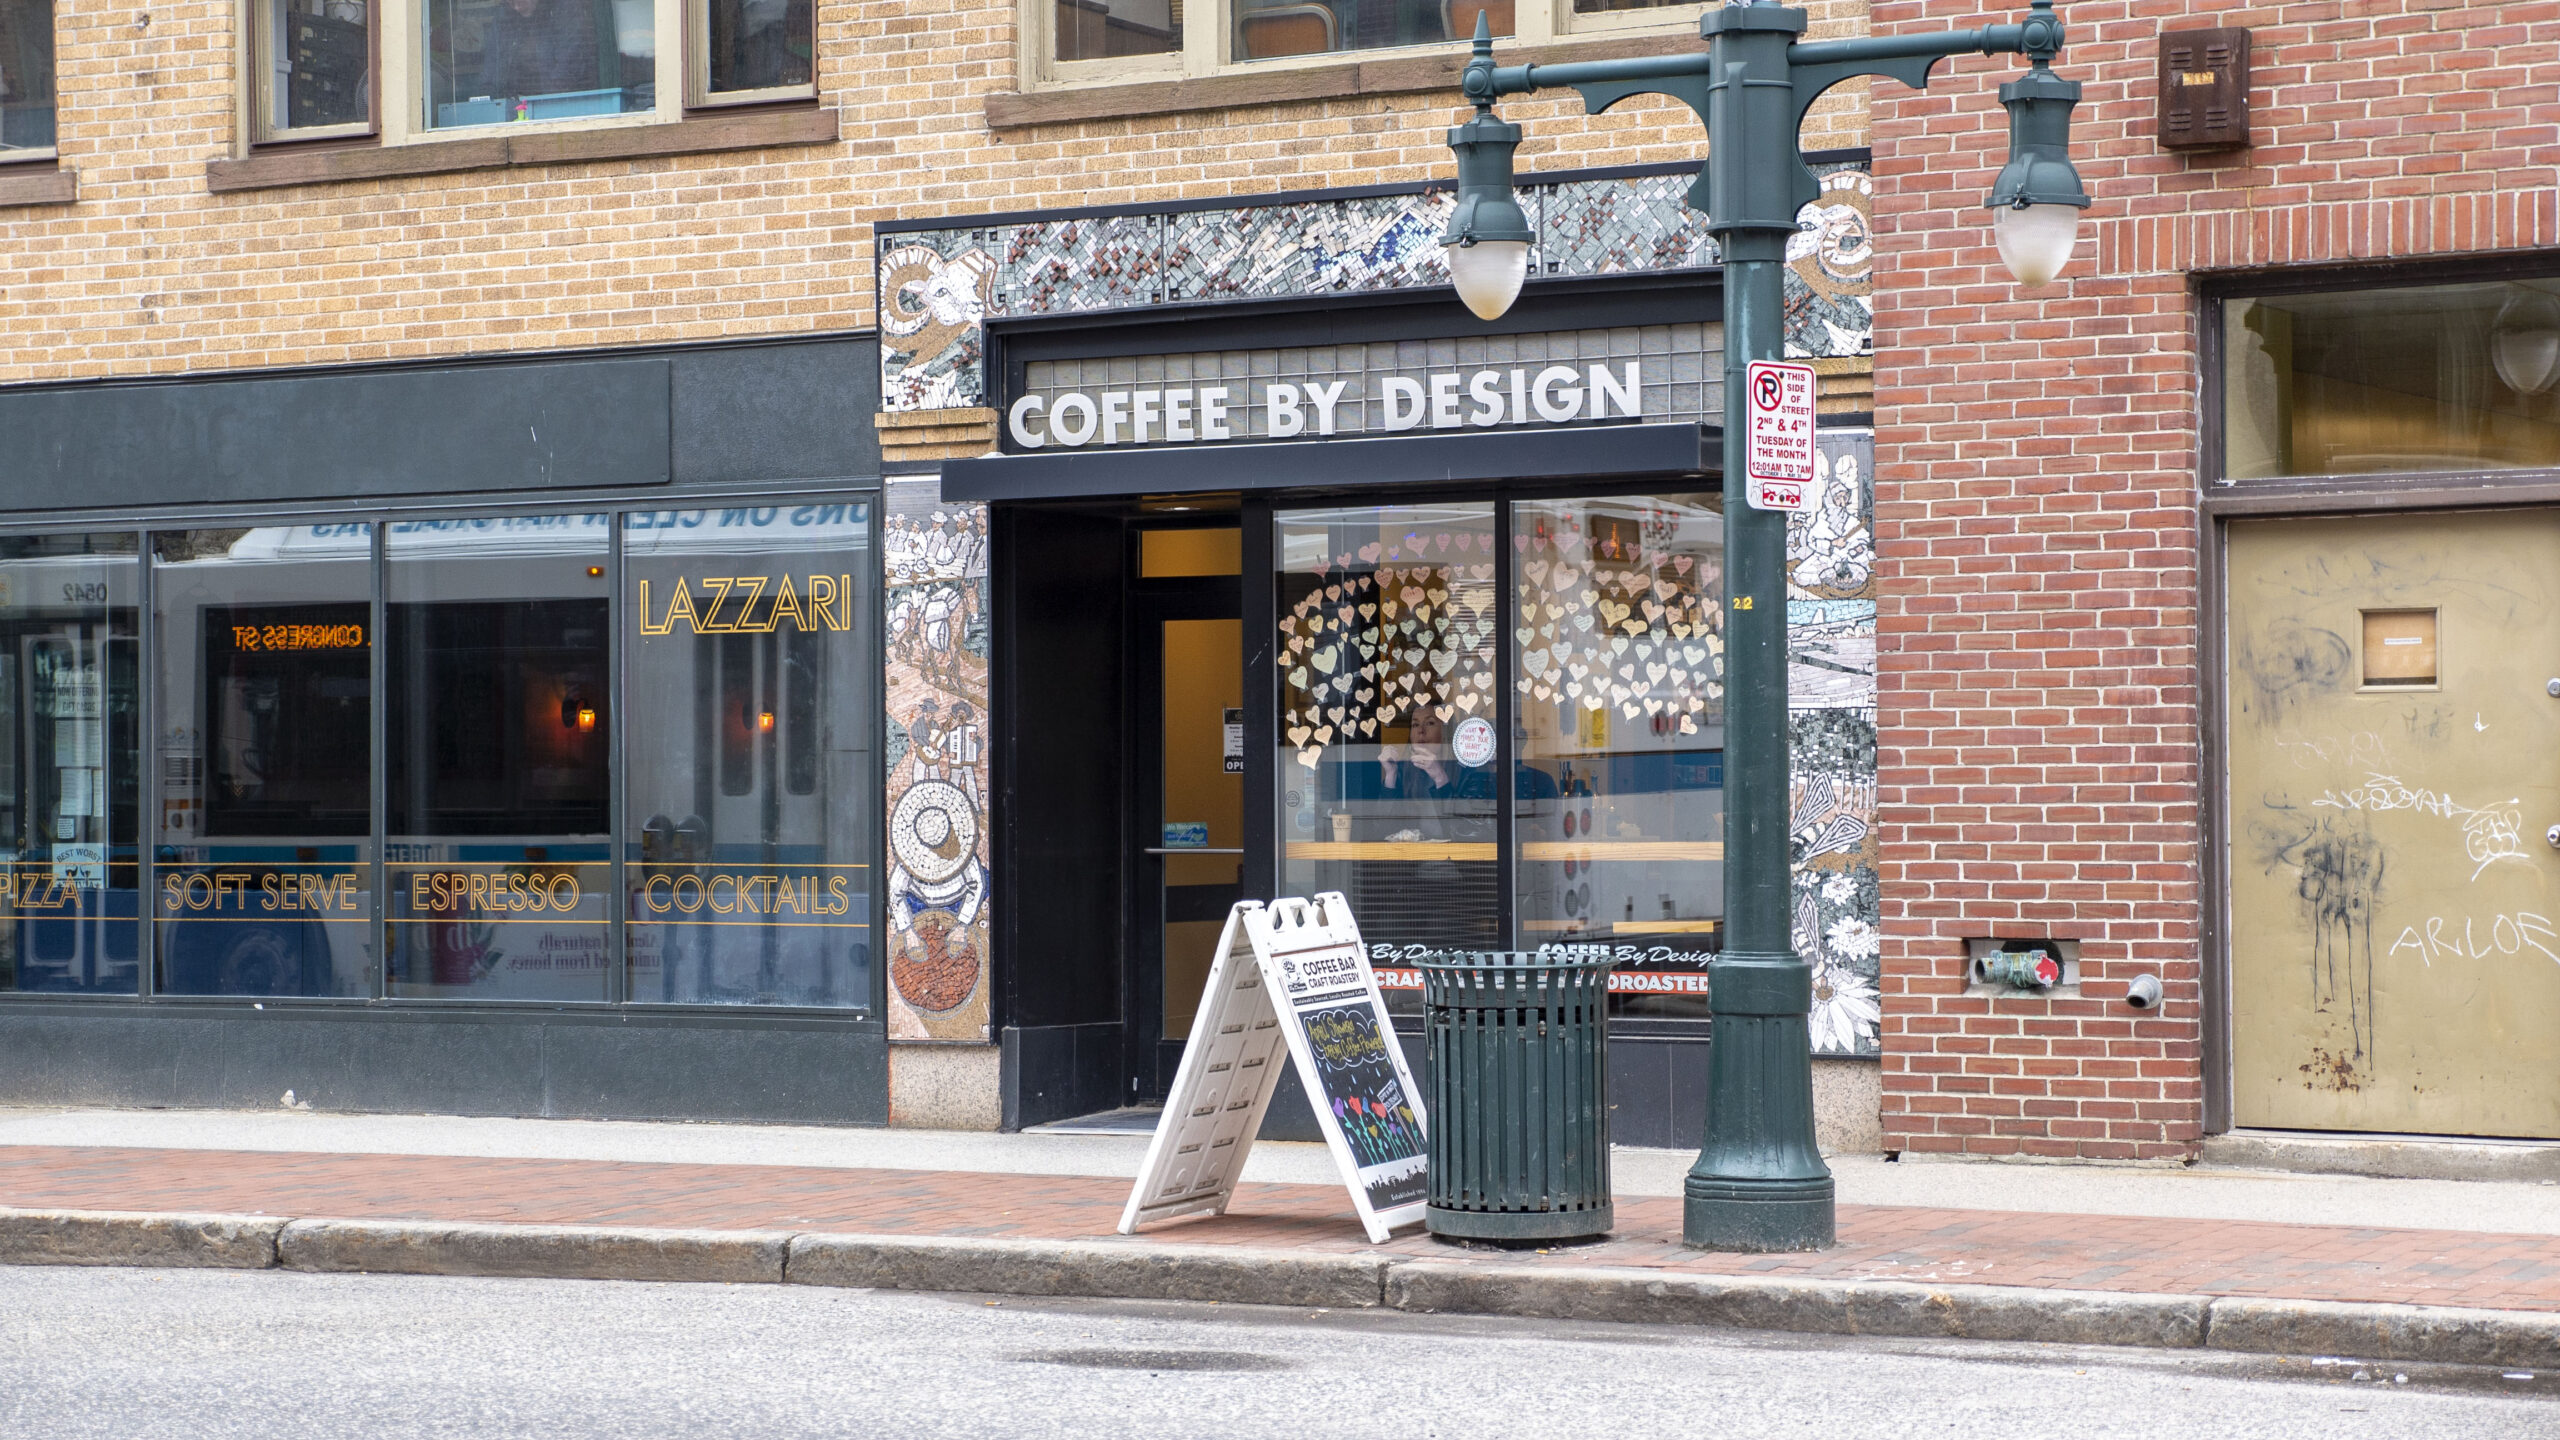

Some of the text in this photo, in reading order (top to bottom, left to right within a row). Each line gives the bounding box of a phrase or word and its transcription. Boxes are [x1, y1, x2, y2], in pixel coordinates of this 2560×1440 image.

[1787, 372, 1805, 381] THIS
[1787, 384, 1805, 392] SIDE
[1009, 361, 1641, 448] COFFEE BY DESIGN
[1791, 395, 1801, 403] OF
[1781, 406, 1810, 415] STREET
[1778, 418, 1786, 431] &
[1756, 435, 1807, 447] TUESDAY OF
[1757, 448, 1806, 460] THE MONTH
[1752, 461, 1811, 474] 12:01AM TO 7AM
[639, 573, 852, 635] LAZZARI
[1733, 597, 1752, 610] 22
[1226, 761, 1244, 770] OPE
[0, 872, 82, 908] PIZZA
[166, 873, 358, 911] SOFT SERVE
[412, 873, 580, 912] ESPRESSO
[645, 873, 849, 915] COCKTAILS
[1372, 944, 1403, 963] By
[1615, 945, 1647, 966] By
[1303, 956, 1357, 976] COFFEE BAR
[1308, 976, 1329, 988] CRAFT
[1330, 972, 1360, 986] ROASTERY
[1376, 971, 1425, 987] CRAF
